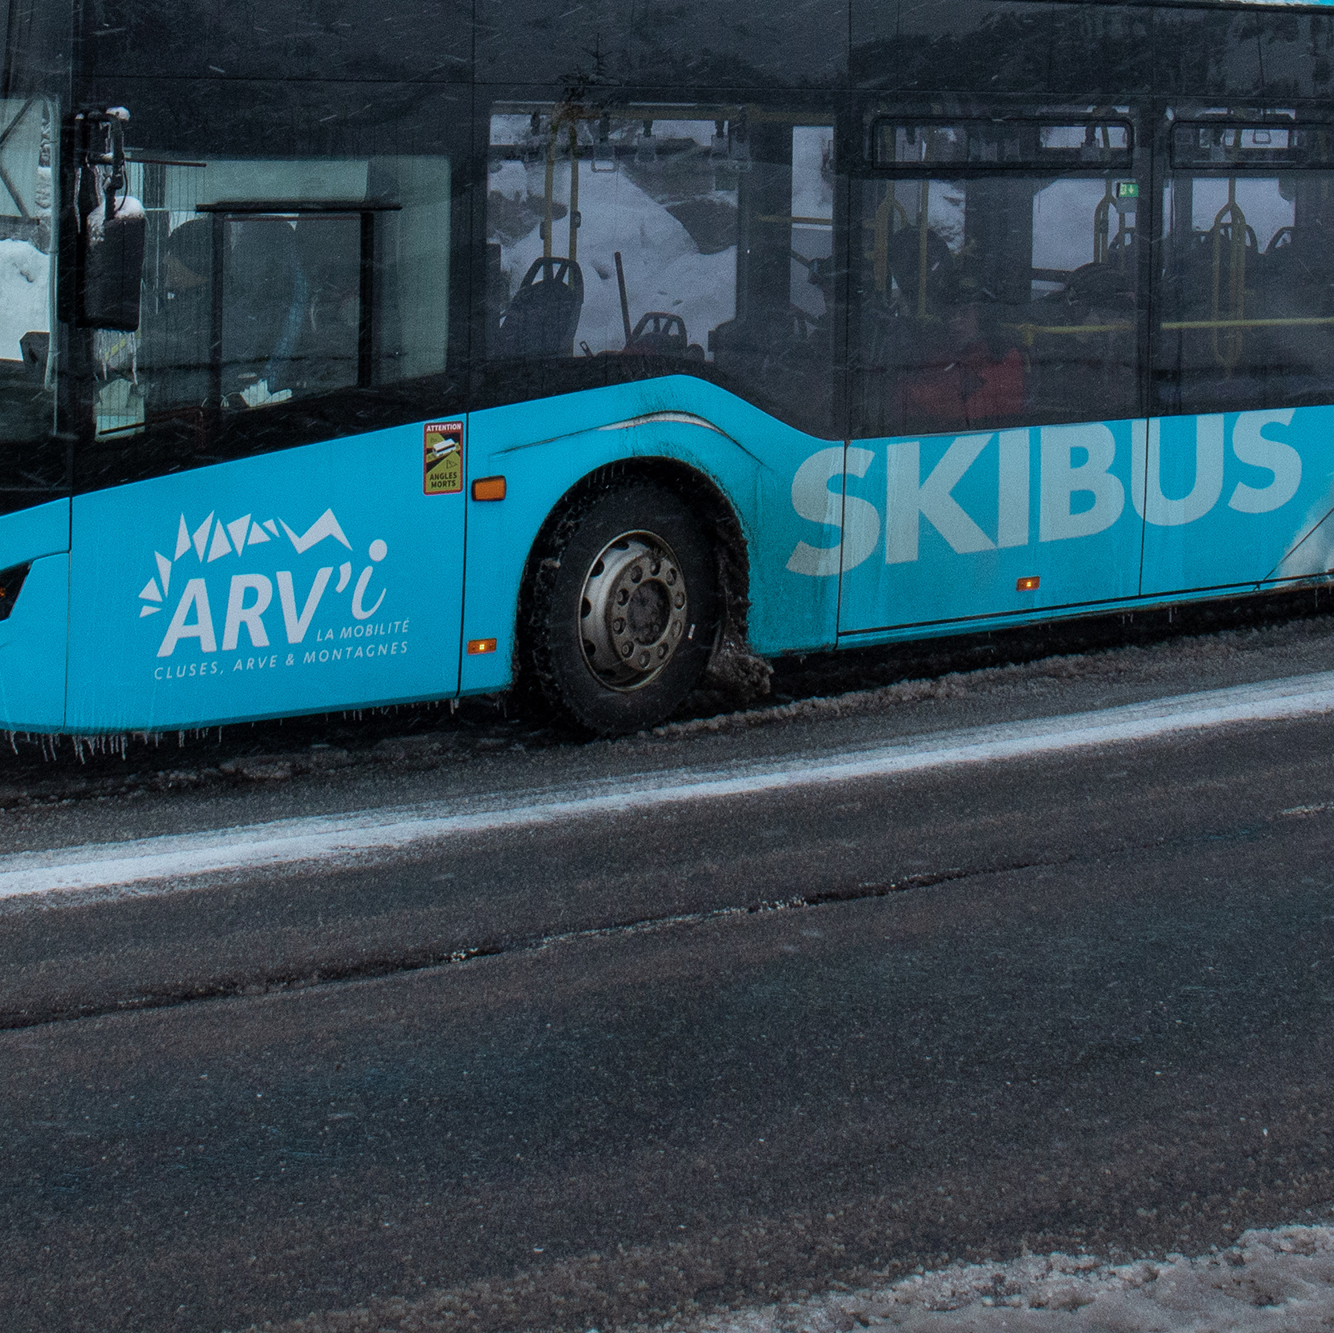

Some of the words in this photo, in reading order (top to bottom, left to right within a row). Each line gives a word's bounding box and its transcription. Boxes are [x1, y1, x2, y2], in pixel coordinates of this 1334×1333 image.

[427, 423, 462, 432] ATTENTION
[430, 471, 457, 481] ANGLES
[431, 479, 456, 489] MORTS
[785, 408, 1302, 577] SKIBUS
[316, 629, 335, 643] LA
[339, 617, 410, 640] MOBILITÉ
[154, 661, 224, 681] CLUSES,
[233, 654, 278, 672] ARVE
[285, 653, 295, 667] &
[303, 641, 409, 665] MONTAGNES
